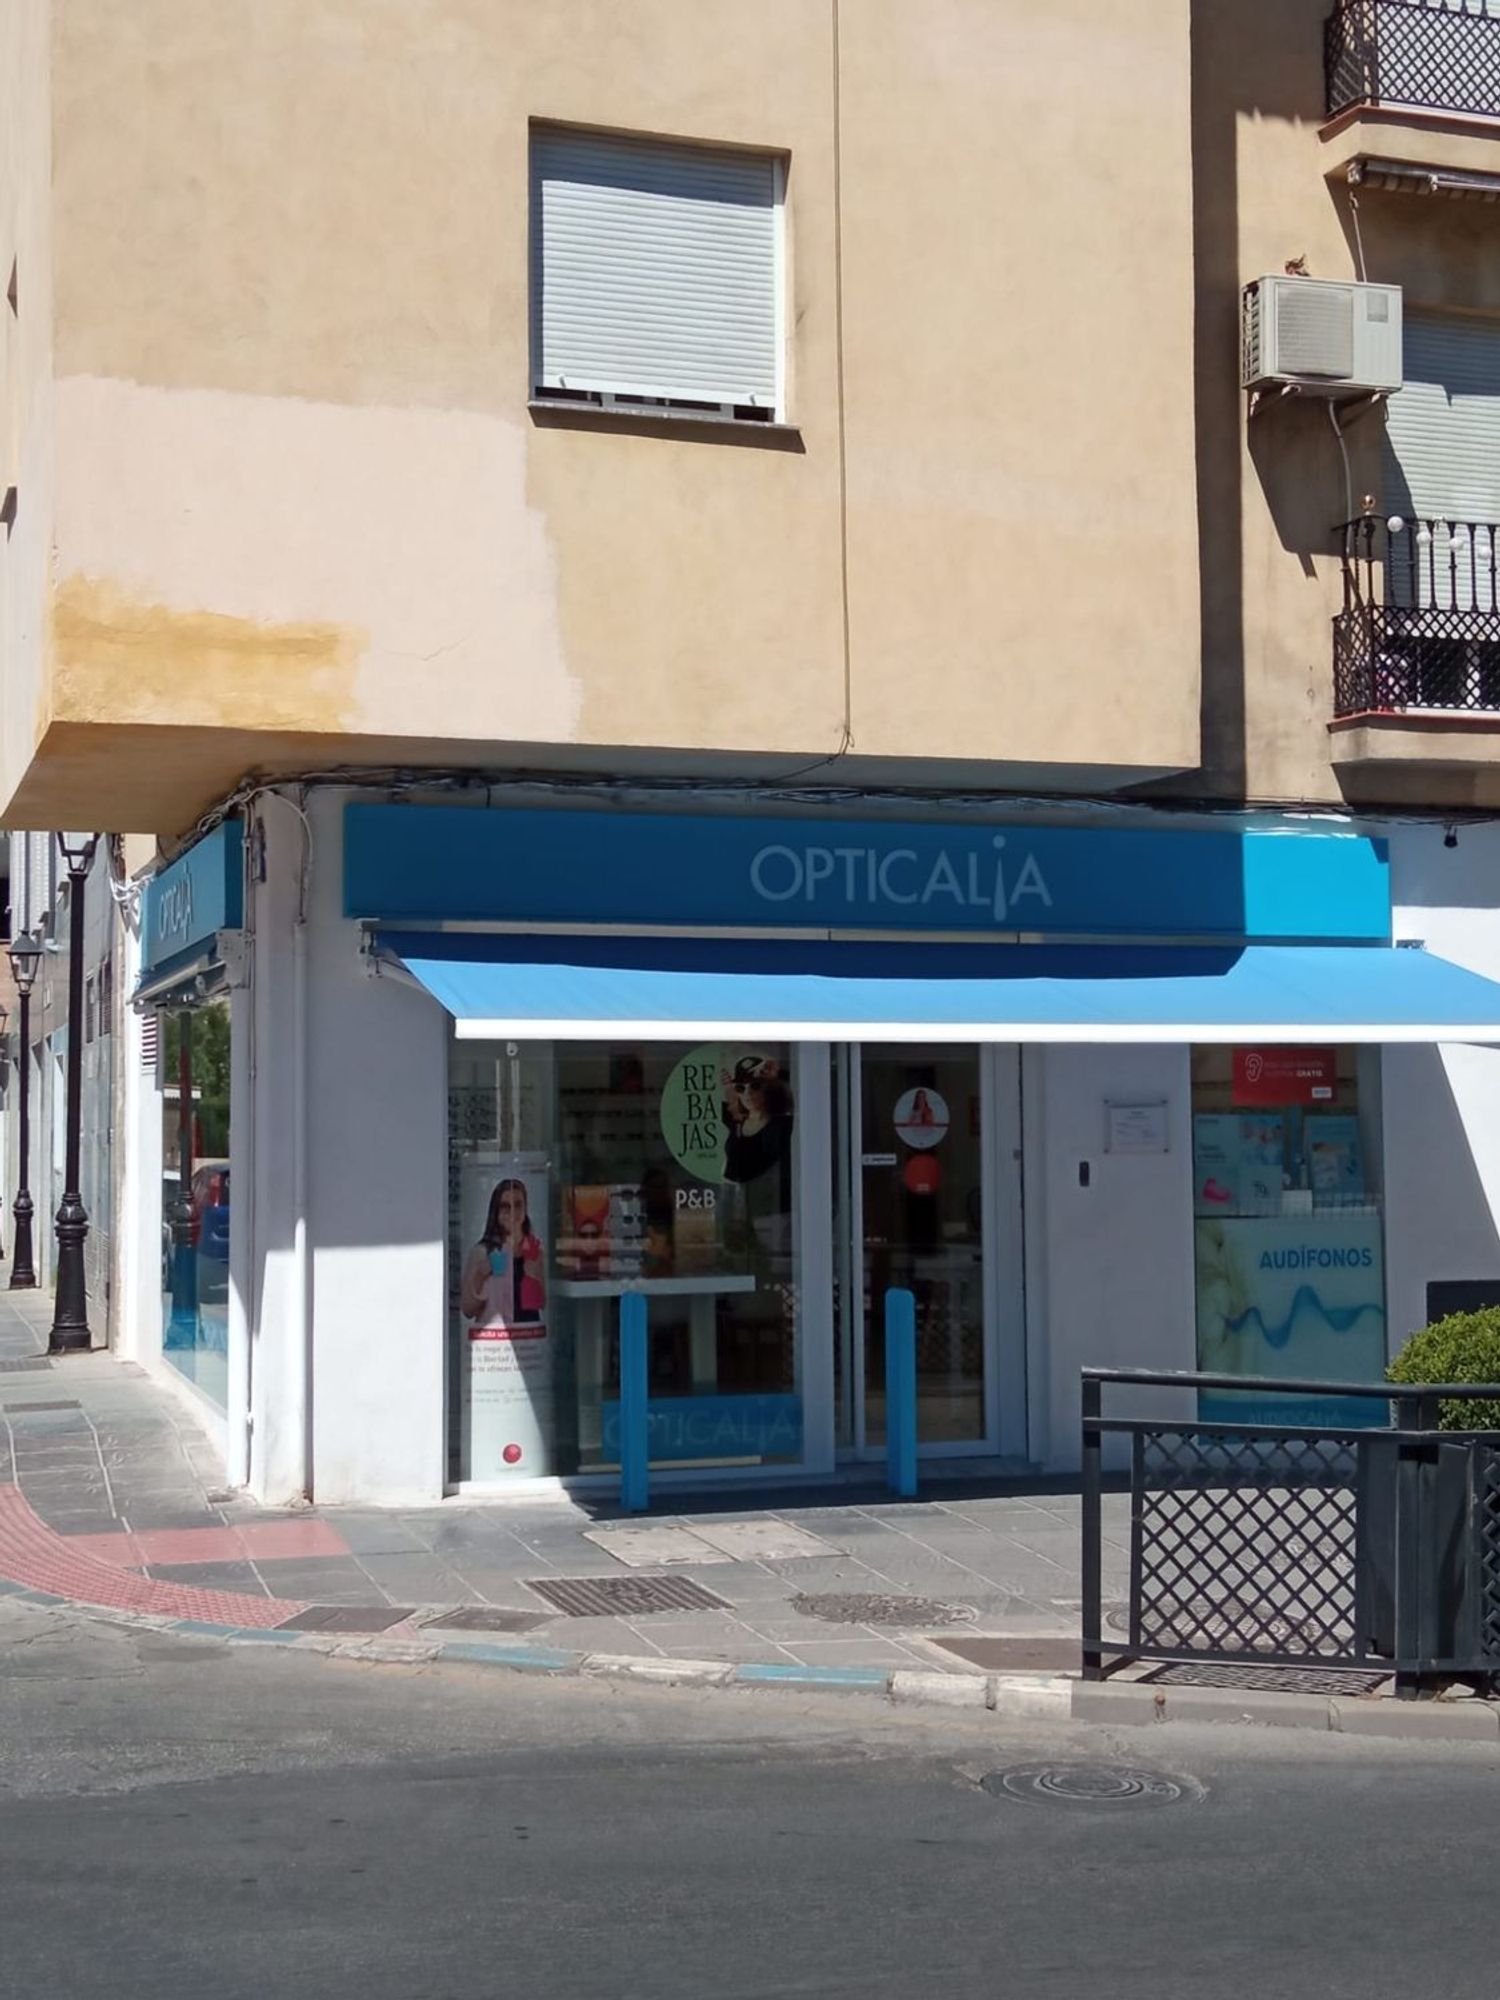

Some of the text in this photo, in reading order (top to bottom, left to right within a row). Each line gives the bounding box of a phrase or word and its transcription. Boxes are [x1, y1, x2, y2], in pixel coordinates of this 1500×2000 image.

[682, 1064, 716, 1092] RE
[687, 1093, 718, 1121] BA
[678, 1122, 718, 1157] JAS
[675, 1189, 716, 1209] P&B
[1259, 1245, 1373, 1271] AUDÍFONOS
